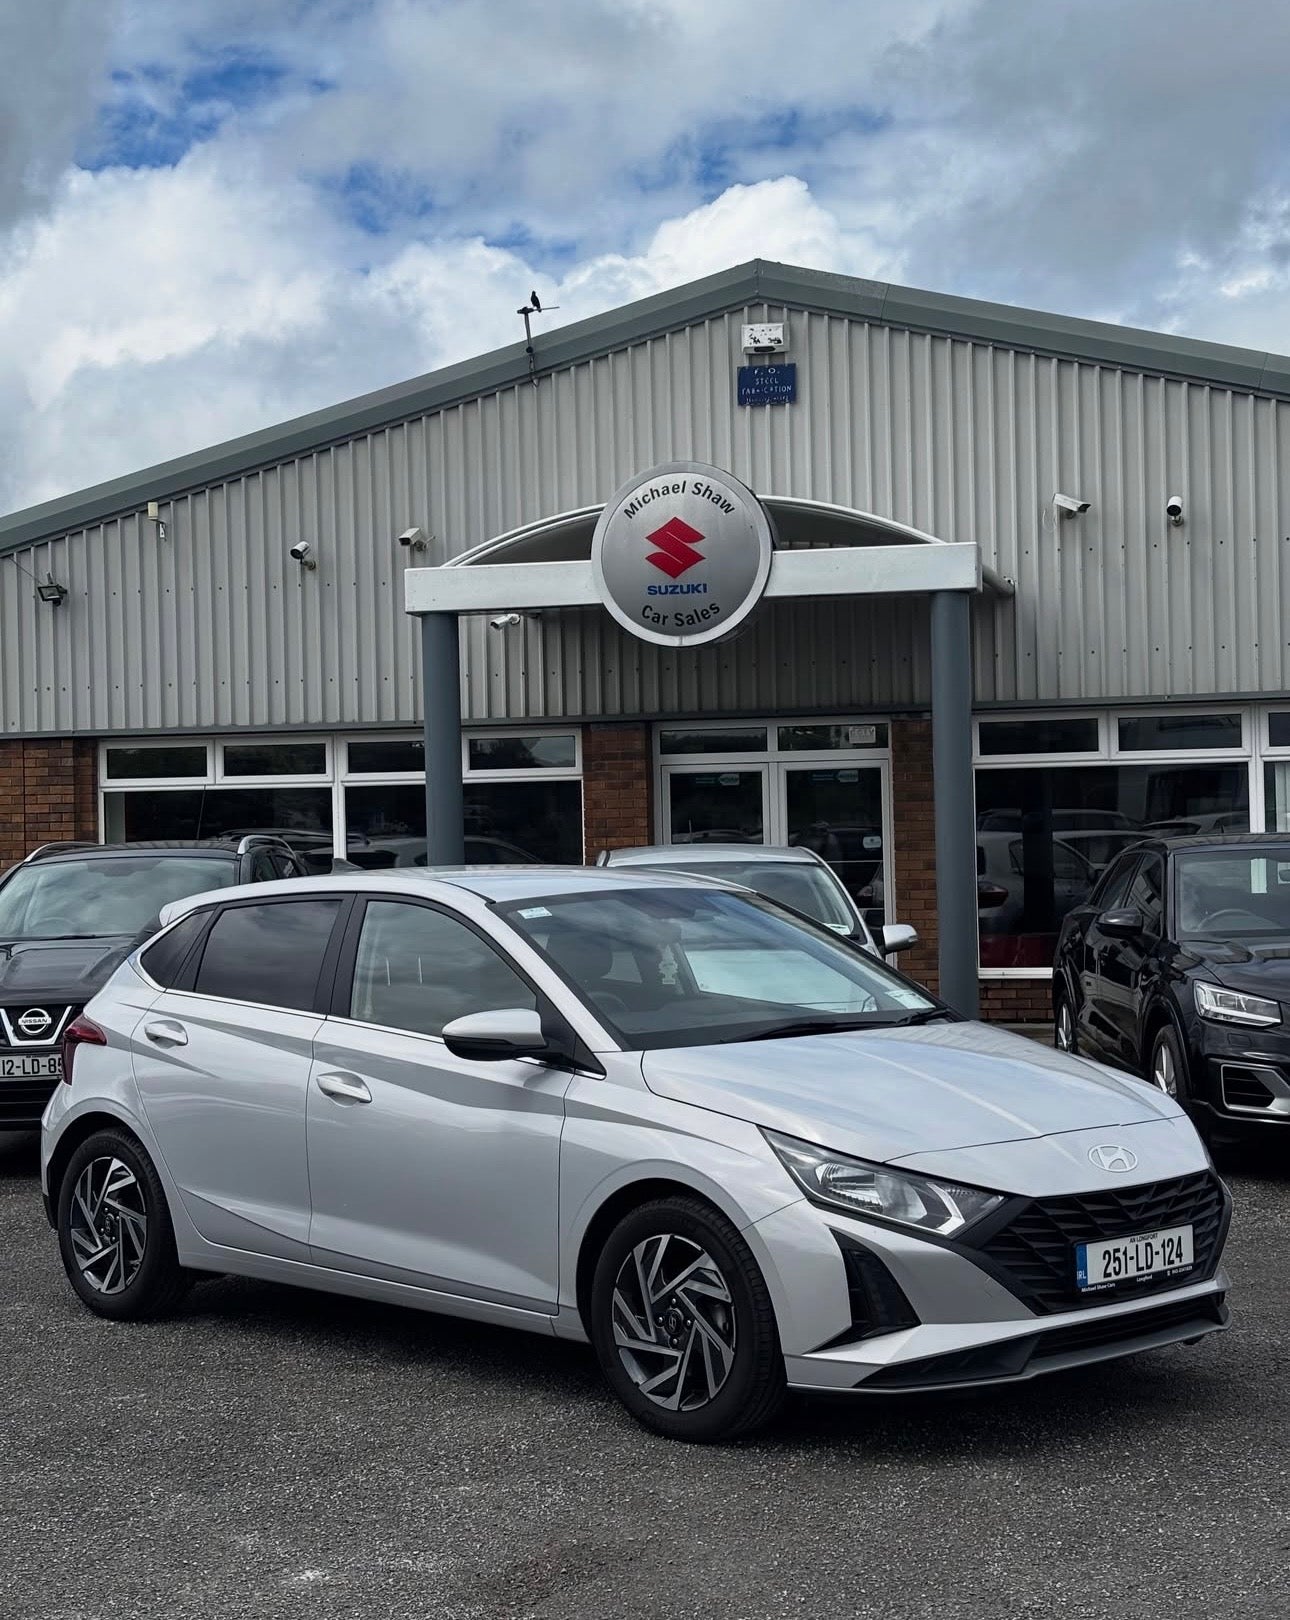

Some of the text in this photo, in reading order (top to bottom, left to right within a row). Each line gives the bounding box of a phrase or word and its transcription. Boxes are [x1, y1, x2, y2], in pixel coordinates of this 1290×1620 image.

[623, 480, 735, 519] Michael Shaw
[647, 583, 708, 596] SUZUKI
[642, 602, 720, 627] Car Sales
[1102, 1235, 1184, 1279] 251-LD-124
[1076, 1270, 1086, 1281] IRL
